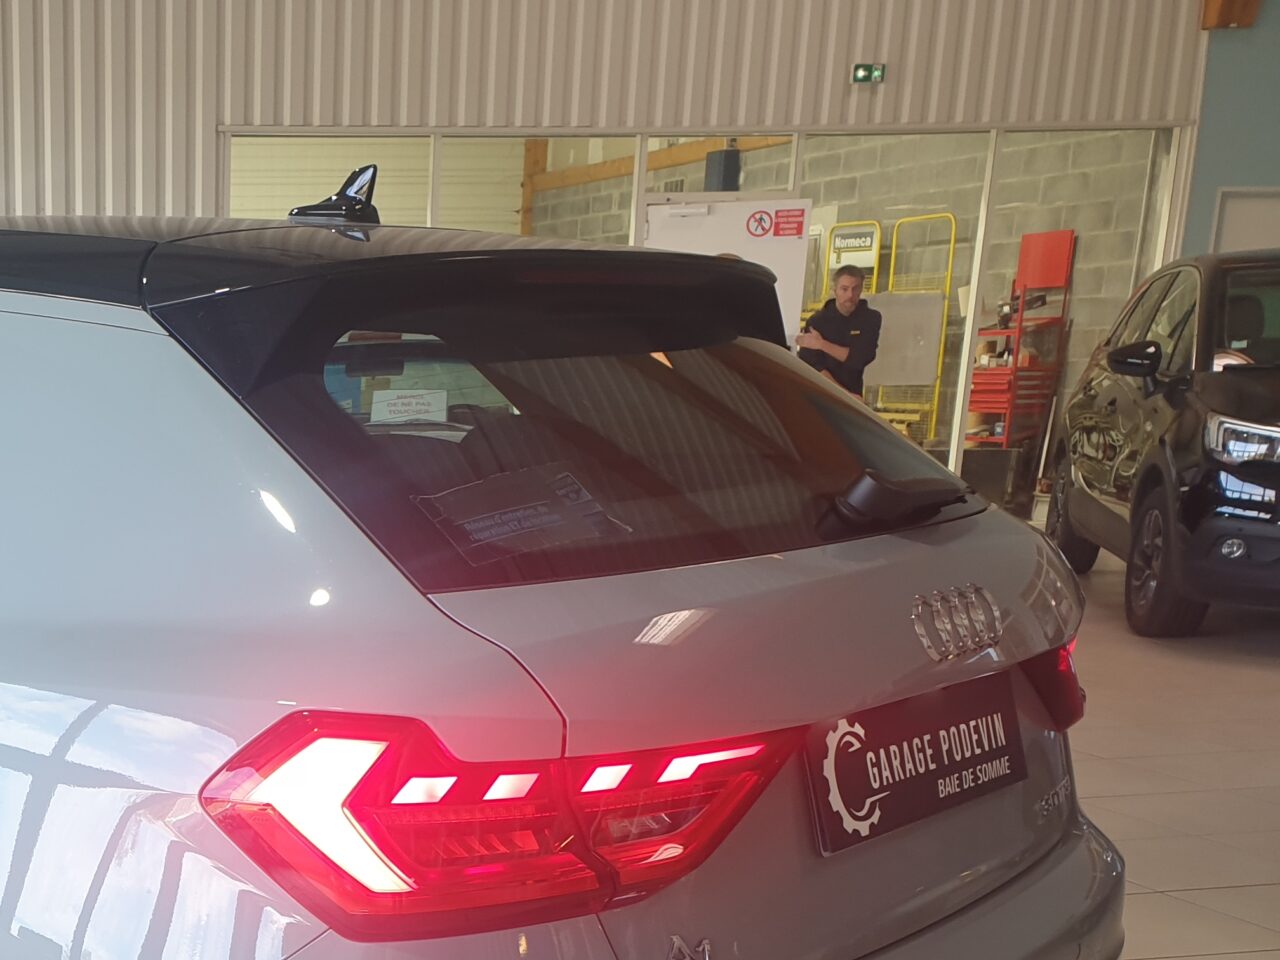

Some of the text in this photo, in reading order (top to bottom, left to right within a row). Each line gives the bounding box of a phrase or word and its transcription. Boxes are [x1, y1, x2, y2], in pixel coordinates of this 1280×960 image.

[835, 236, 871, 249] Normeca
[866, 712, 1006, 789] GARAGE PODEVIN
[938, 755, 1011, 798] BAIE DE SOMME
